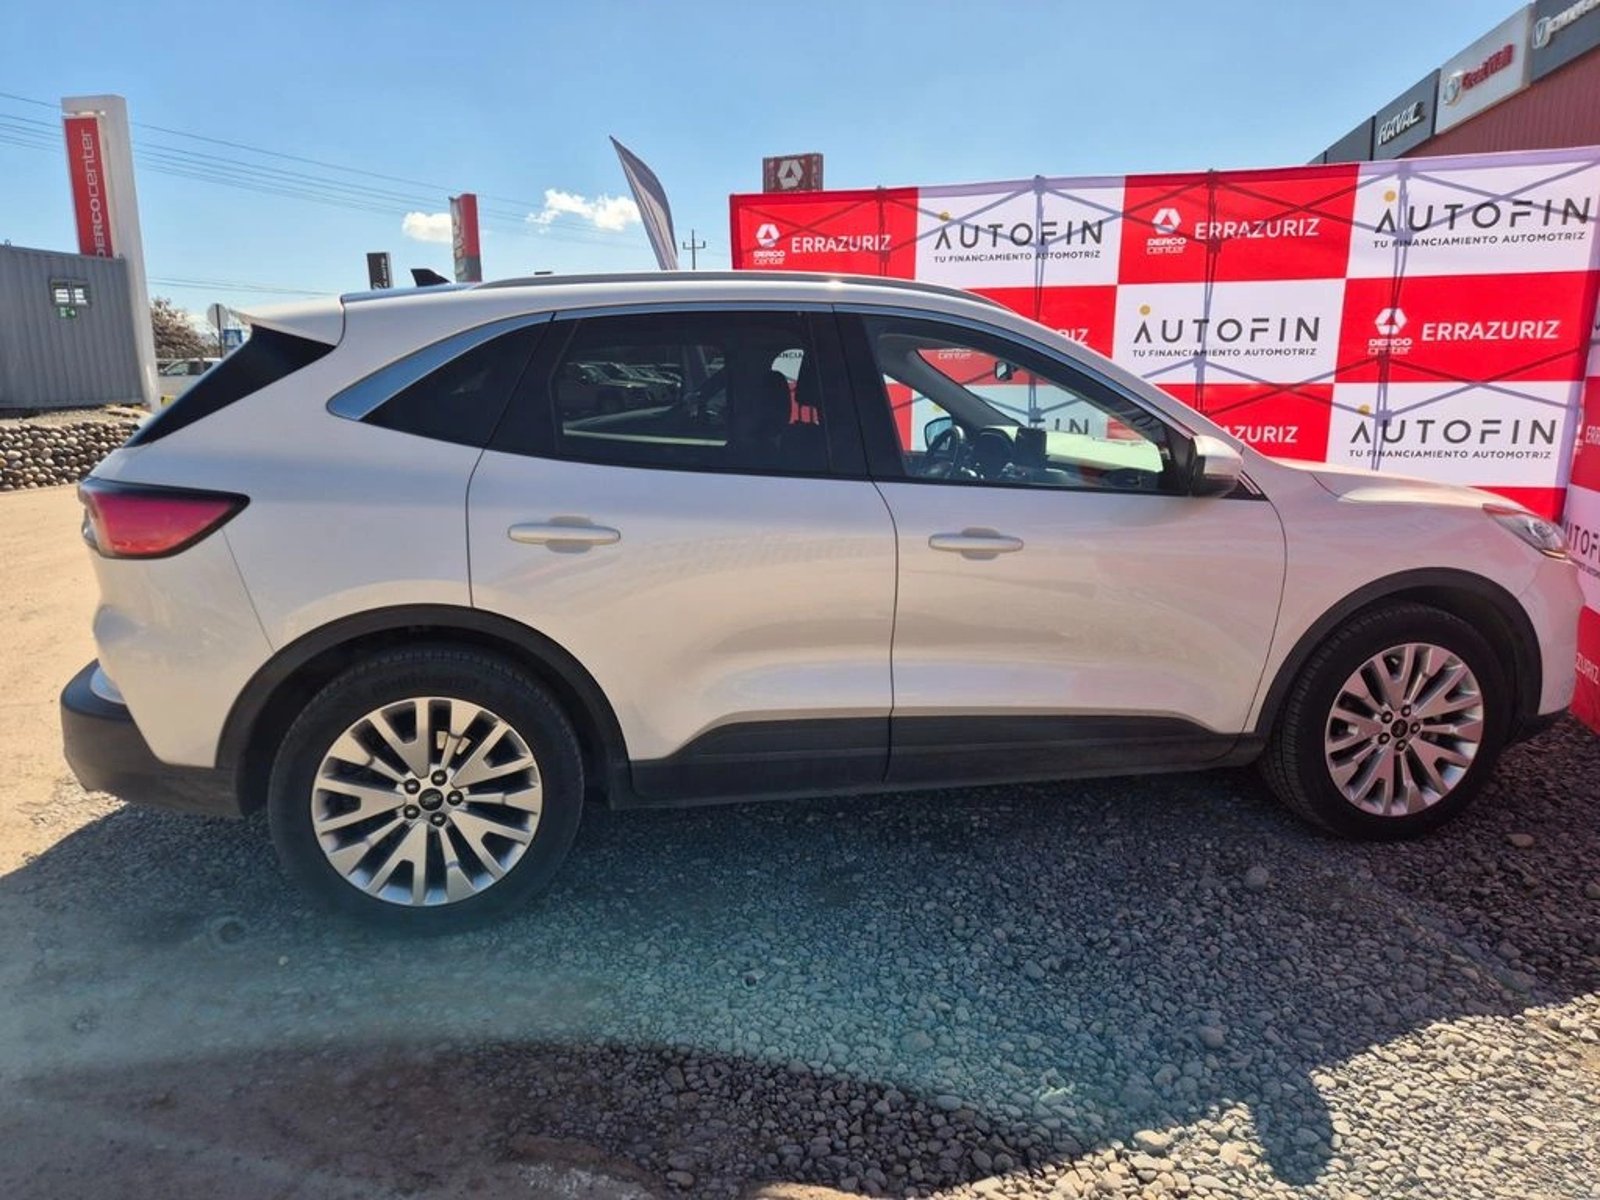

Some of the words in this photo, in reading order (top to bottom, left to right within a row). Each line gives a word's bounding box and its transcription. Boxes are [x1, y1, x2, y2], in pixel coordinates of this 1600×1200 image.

[1376, 197, 1591, 233] AUTOFIN
[934, 219, 1103, 250] AUTOFIN
[1195, 218, 1320, 241] ERRAZURIZ
[1374, 240, 1389, 248] TU
[1392, 235, 1498, 247] FINANCIAMIENTO
[1502, 231, 1586, 244] AUTOMOTRIZ
[791, 234, 891, 254] ERRAZURIZ
[949, 252, 1032, 262] FINANCIAMIENTO
[1035, 251, 1101, 260] AUTOMOTRIZ
[1133, 316, 1320, 343] AUTOFIN
[1421, 320, 1560, 342] ERRAZURIZ
[1133, 349, 1146, 357] TU
[1148, 348, 1241, 357] FINANCIAMIENTO
[1244, 348, 1317, 357] AUTOMOTRIZ
[1350, 419, 1557, 444] AUTOFIN
[1349, 450, 1364, 458] TU
[1367, 450, 1469, 459] FINANCIAMIENTO
[1472, 450, 1552, 459] AUTOMOTRIZ
